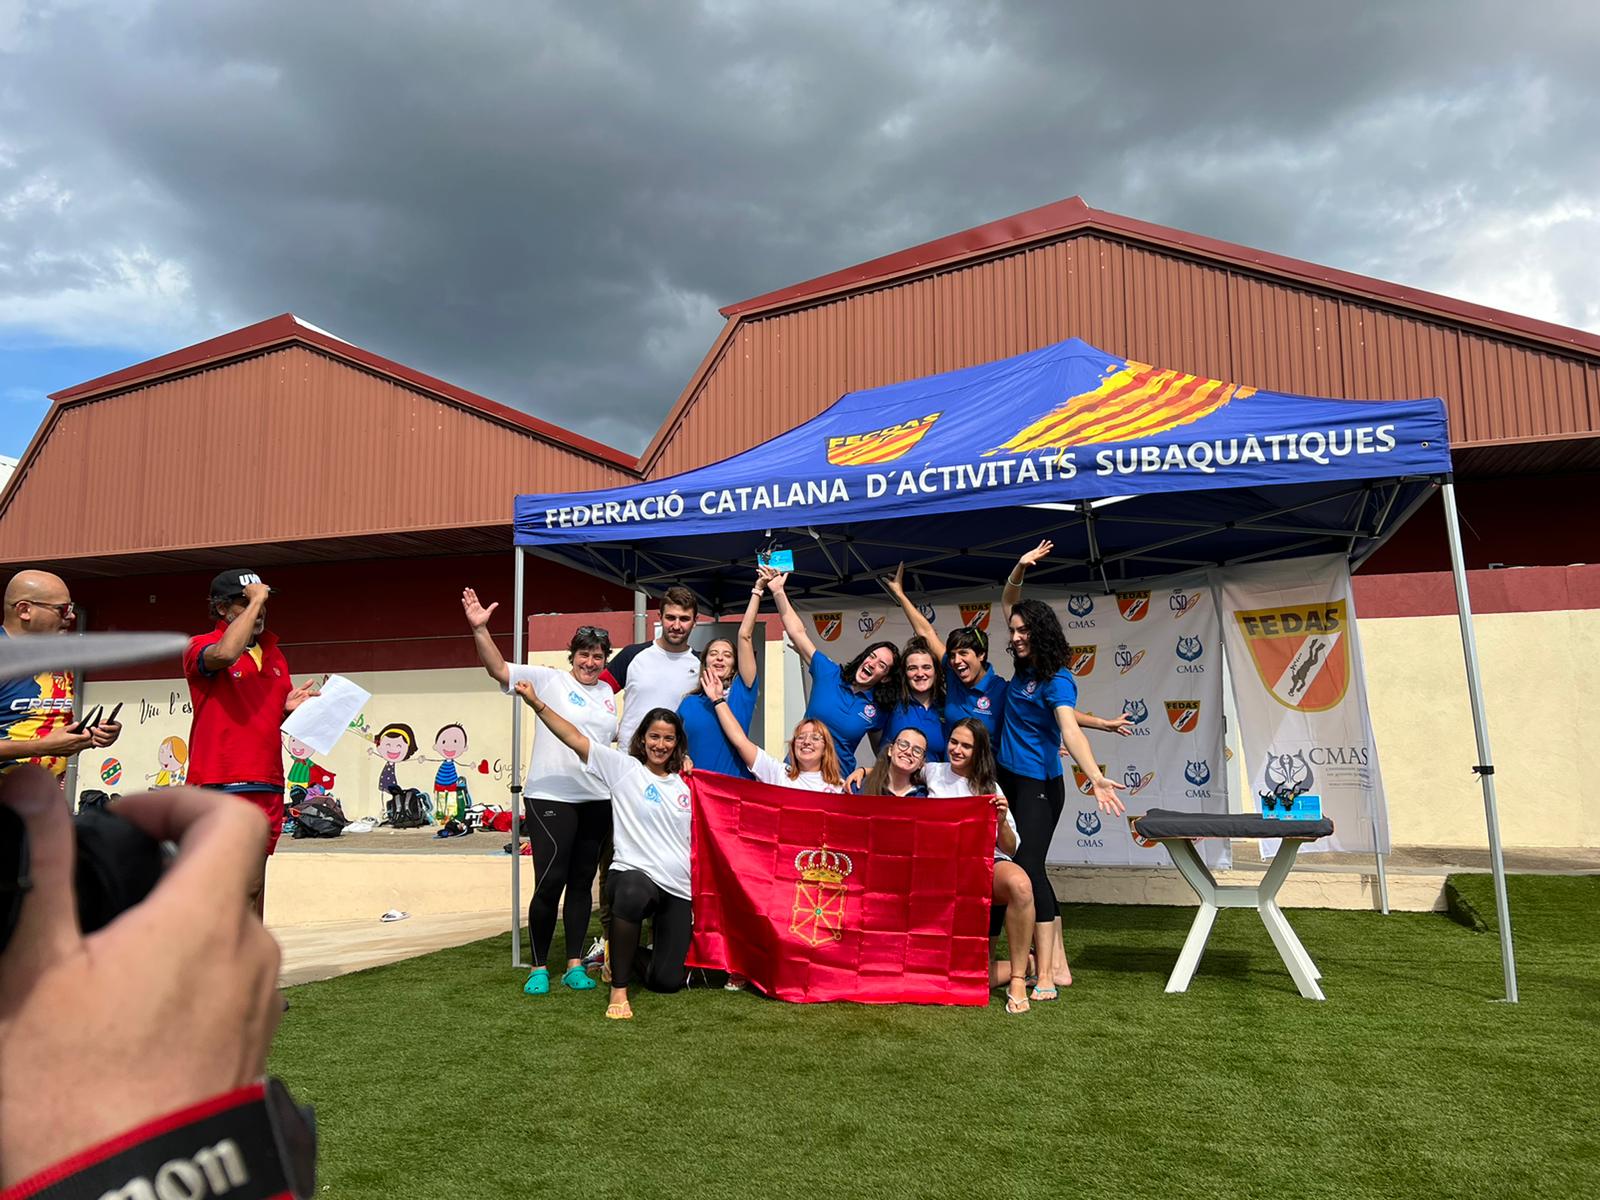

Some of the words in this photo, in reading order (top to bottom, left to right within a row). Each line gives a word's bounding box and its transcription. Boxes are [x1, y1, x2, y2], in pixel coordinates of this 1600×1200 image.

[545, 489, 684, 529] FEDERACIÓ
[699, 478, 850, 515] CATALANA
[1117, 590, 1149, 600] FEDAS
[959, 603, 989, 611] FEDAS
[1169, 594, 1188, 611] CSD
[813, 613, 841, 621] FEDAS
[1241, 608, 1340, 636] FEDAS
[858, 617, 874, 633] CSD
[1068, 619, 1096, 630] CMAS
[1114, 650, 1133, 667] CSD
[1176, 664, 1205, 674] CMAS
[1166, 701, 1199, 710] FEDAS
[1130, 727, 1151, 737] MAS
[1308, 747, 1369, 766] CMAS
[1123, 771, 1141, 788] CSD
[1185, 789, 1211, 799] CMAS
[1076, 839, 1104, 848] CMAS
